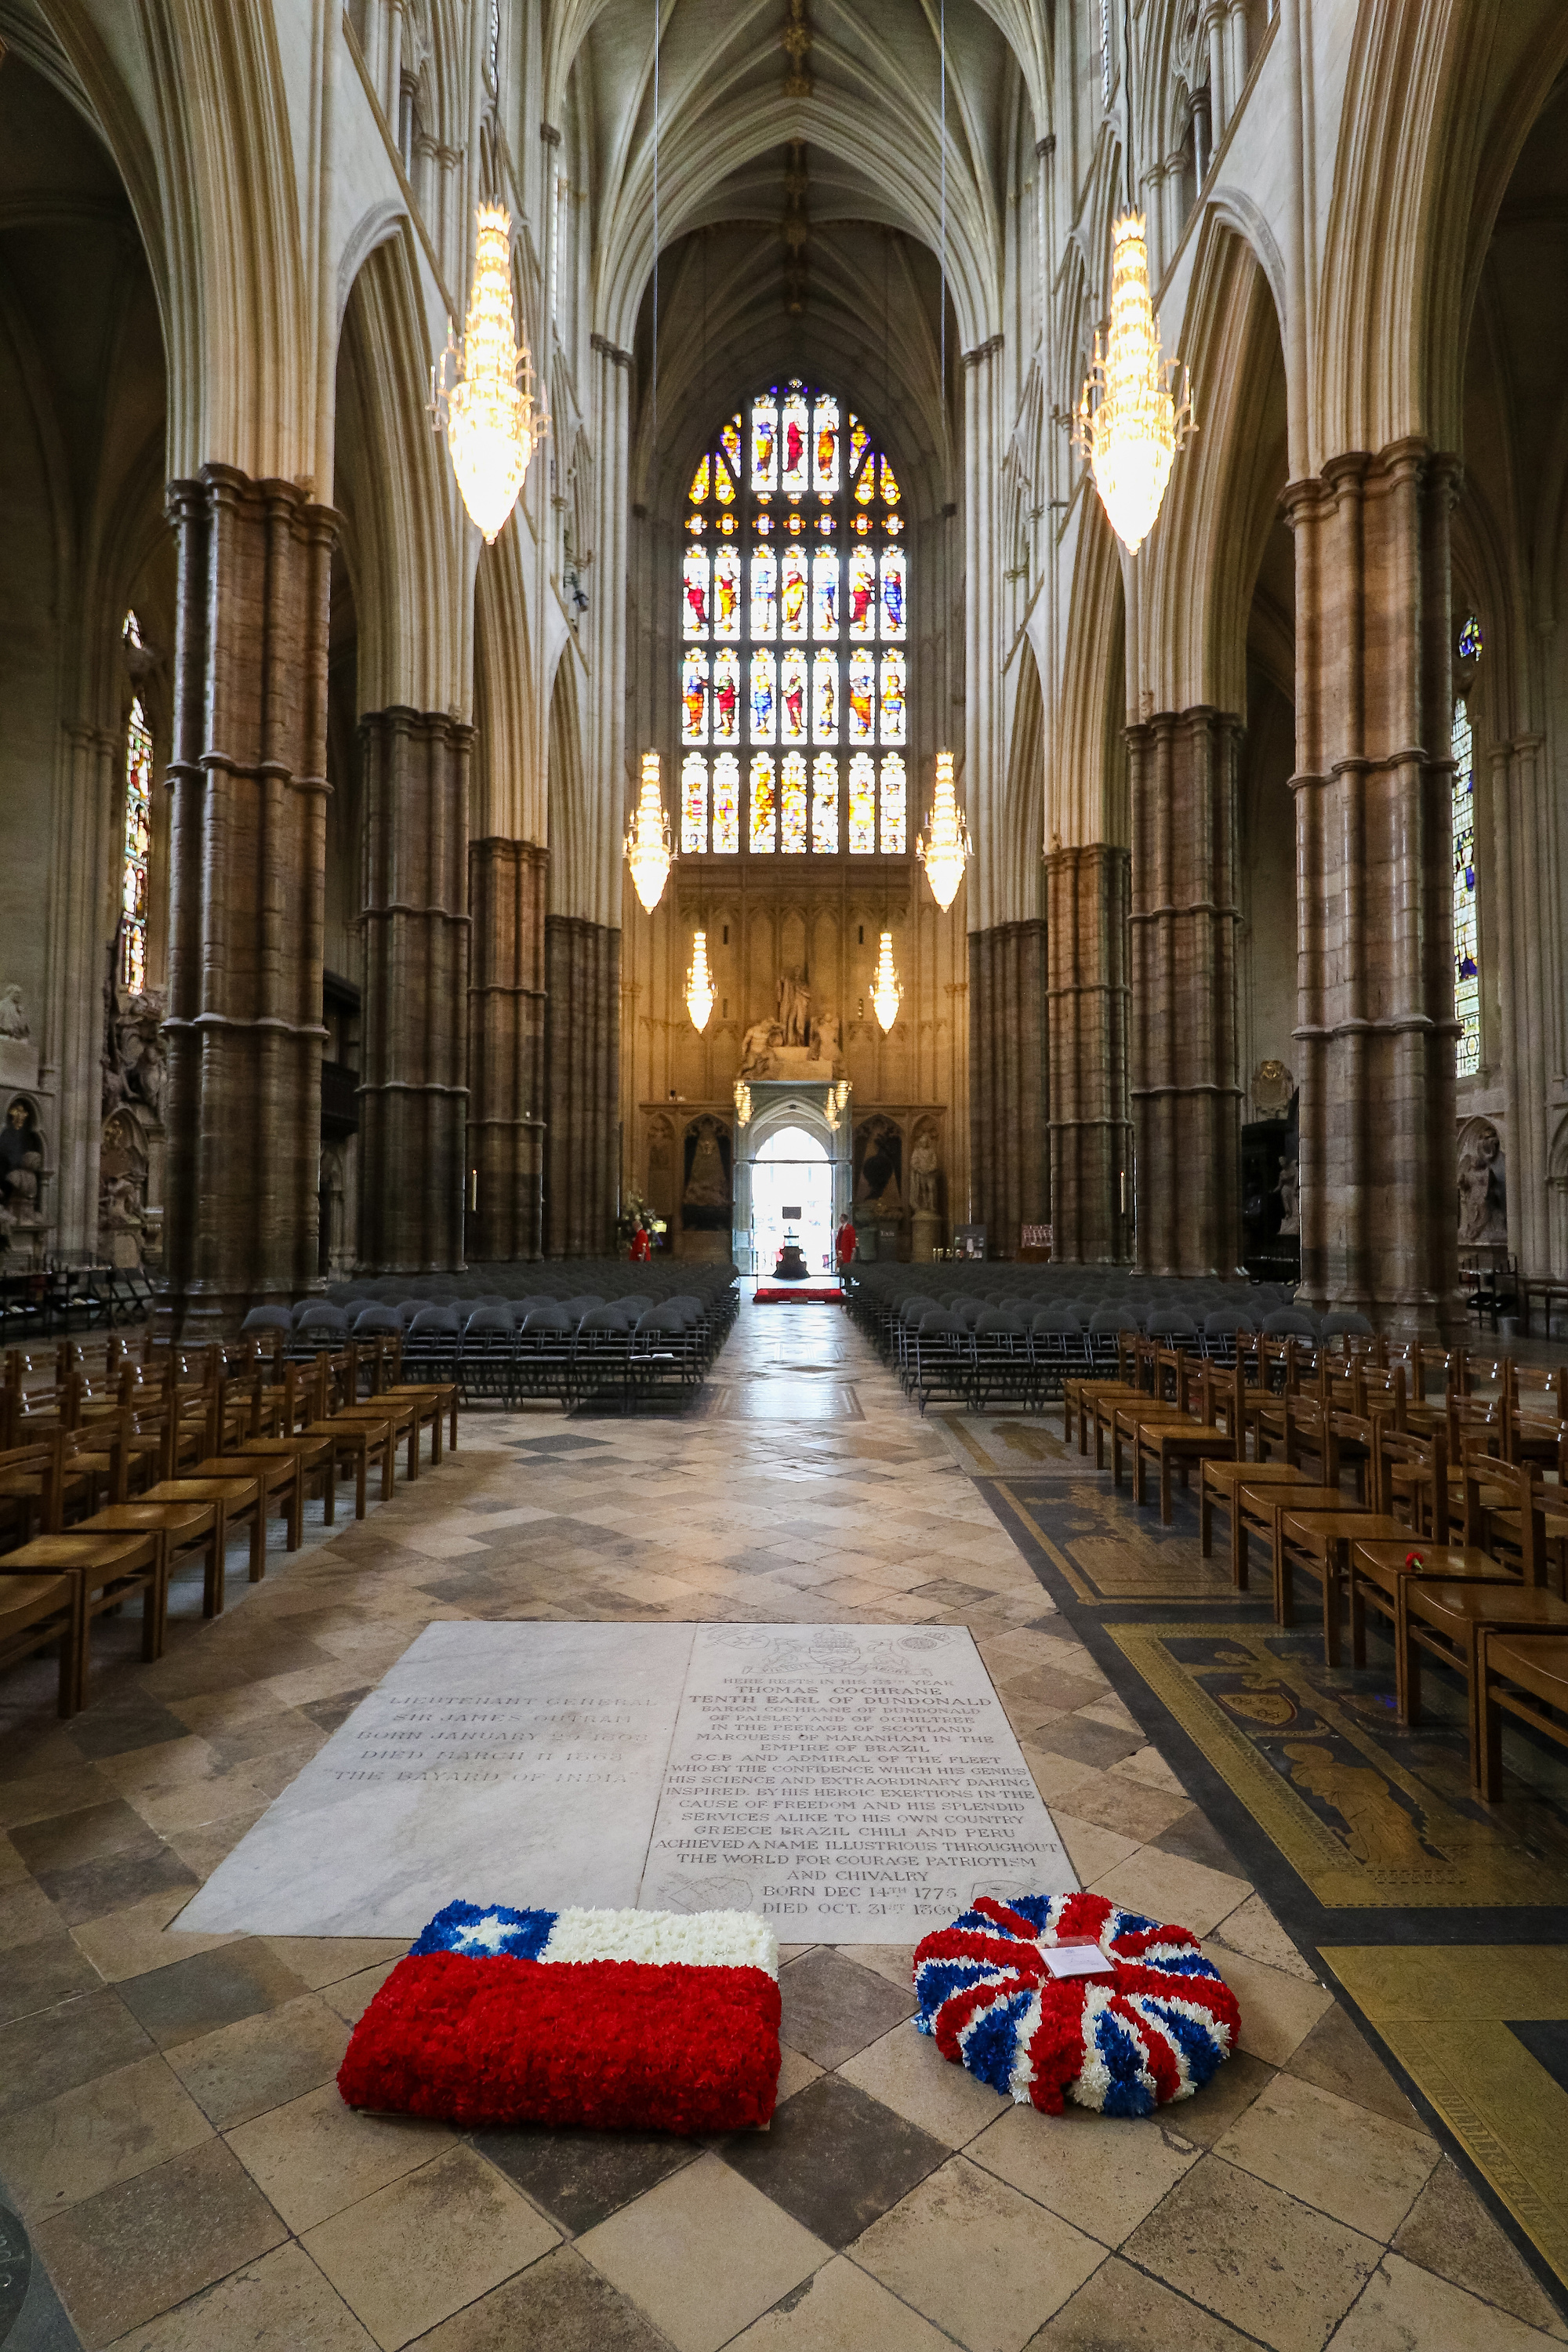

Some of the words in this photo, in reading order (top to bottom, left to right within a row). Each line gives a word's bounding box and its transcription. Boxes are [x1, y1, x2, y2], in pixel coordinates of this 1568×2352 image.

[833, 1686, 942, 1696] COCHRANE
[546, 1697, 658, 1707] GENERAL
[689, 1695, 754, 1704] TENTH
[767, 1696, 819, 1704] EARL
[829, 1696, 853, 1704] OF
[864, 1697, 992, 1706] DUNDONALD
[392, 1713, 433, 1722] SIR
[534, 1715, 631, 1723] OUTRAM
[357, 1731, 423, 1740] BORN
[430, 1731, 538, 1740] JANUARY
[865, 1744, 930, 1753] BRAZIL
[360, 1750, 423, 1759] DIED
[437, 1751, 524, 1760] MARCH
[949, 1756, 1001, 1765] FLEET
[671, 1764, 707, 1773] WHO
[772, 1765, 873, 1773] CONFIDENCE
[879, 1766, 931, 1774] WHICH
[937, 1766, 965, 1775] HIS
[971, 1767, 1026, 1776] GENIUS
[397, 1771, 499, 1781] BAYARD
[512, 1773, 546, 1782] OF
[702, 1776, 775, 1784] SCIENCE
[781, 1777, 816, 1785] AND
[822, 1777, 960, 1787] EXTRAORDINARY
[967, 1778, 1030, 1788] DARING
[757, 1788, 778, 1796] BY
[815, 1788, 876, 1797] HEROIC
[881, 1789, 974, 1798] EXERTIONS
[1000, 1790, 1036, 1799] THE
[679, 1800, 738, 1809] CAUSE
[746, 1800, 768, 1809] OF
[773, 1801, 855, 1809] FREEDOM
[863, 1802, 901, 1810] AND
[908, 1802, 936, 1810] HIS
[942, 1802, 1025, 1812] SPLENDID
[681, 1813, 770, 1821] SERVICES
[775, 1813, 828, 1822] ALIKE
[834, 1813, 856, 1822] TO
[862, 1814, 891, 1823] HIS
[897, 1814, 938, 1824] OWN
[945, 1815, 1024, 1824] COUNTRY
[694, 1825, 771, 1835] GREECE
[781, 1826, 850, 1836] BRAZIL
[858, 1828, 906, 1837] CHILI
[916, 1828, 956, 1838] AND
[965, 1828, 1015, 1838] PERU
[655, 1839, 744, 1849] ACHIEVED
[748, 1840, 760, 1849] A
[764, 1840, 818, 1849] NAME
[826, 1841, 938, 1851] ILLUSTRIOUS
[942, 1842, 1058, 1853] THROUGHOUT
[677, 1853, 717, 1864] THE
[723, 1854, 789, 1864] WORLD
[796, 1854, 831, 1865] FOR
[836, 1855, 919, 1866] COURAGE
[927, 1857, 1036, 1867] PATRIOTISM
[787, 1870, 826, 1881] AND
[836, 1871, 929, 1882] CHIVALRY
[763, 1886, 815, 1896] BORN
[825, 1886, 861, 1897] DEC
[914, 1887, 956, 1900] 1775
[762, 1902, 808, 1914] DIED
[913, 1904, 960, 1915] 1860
